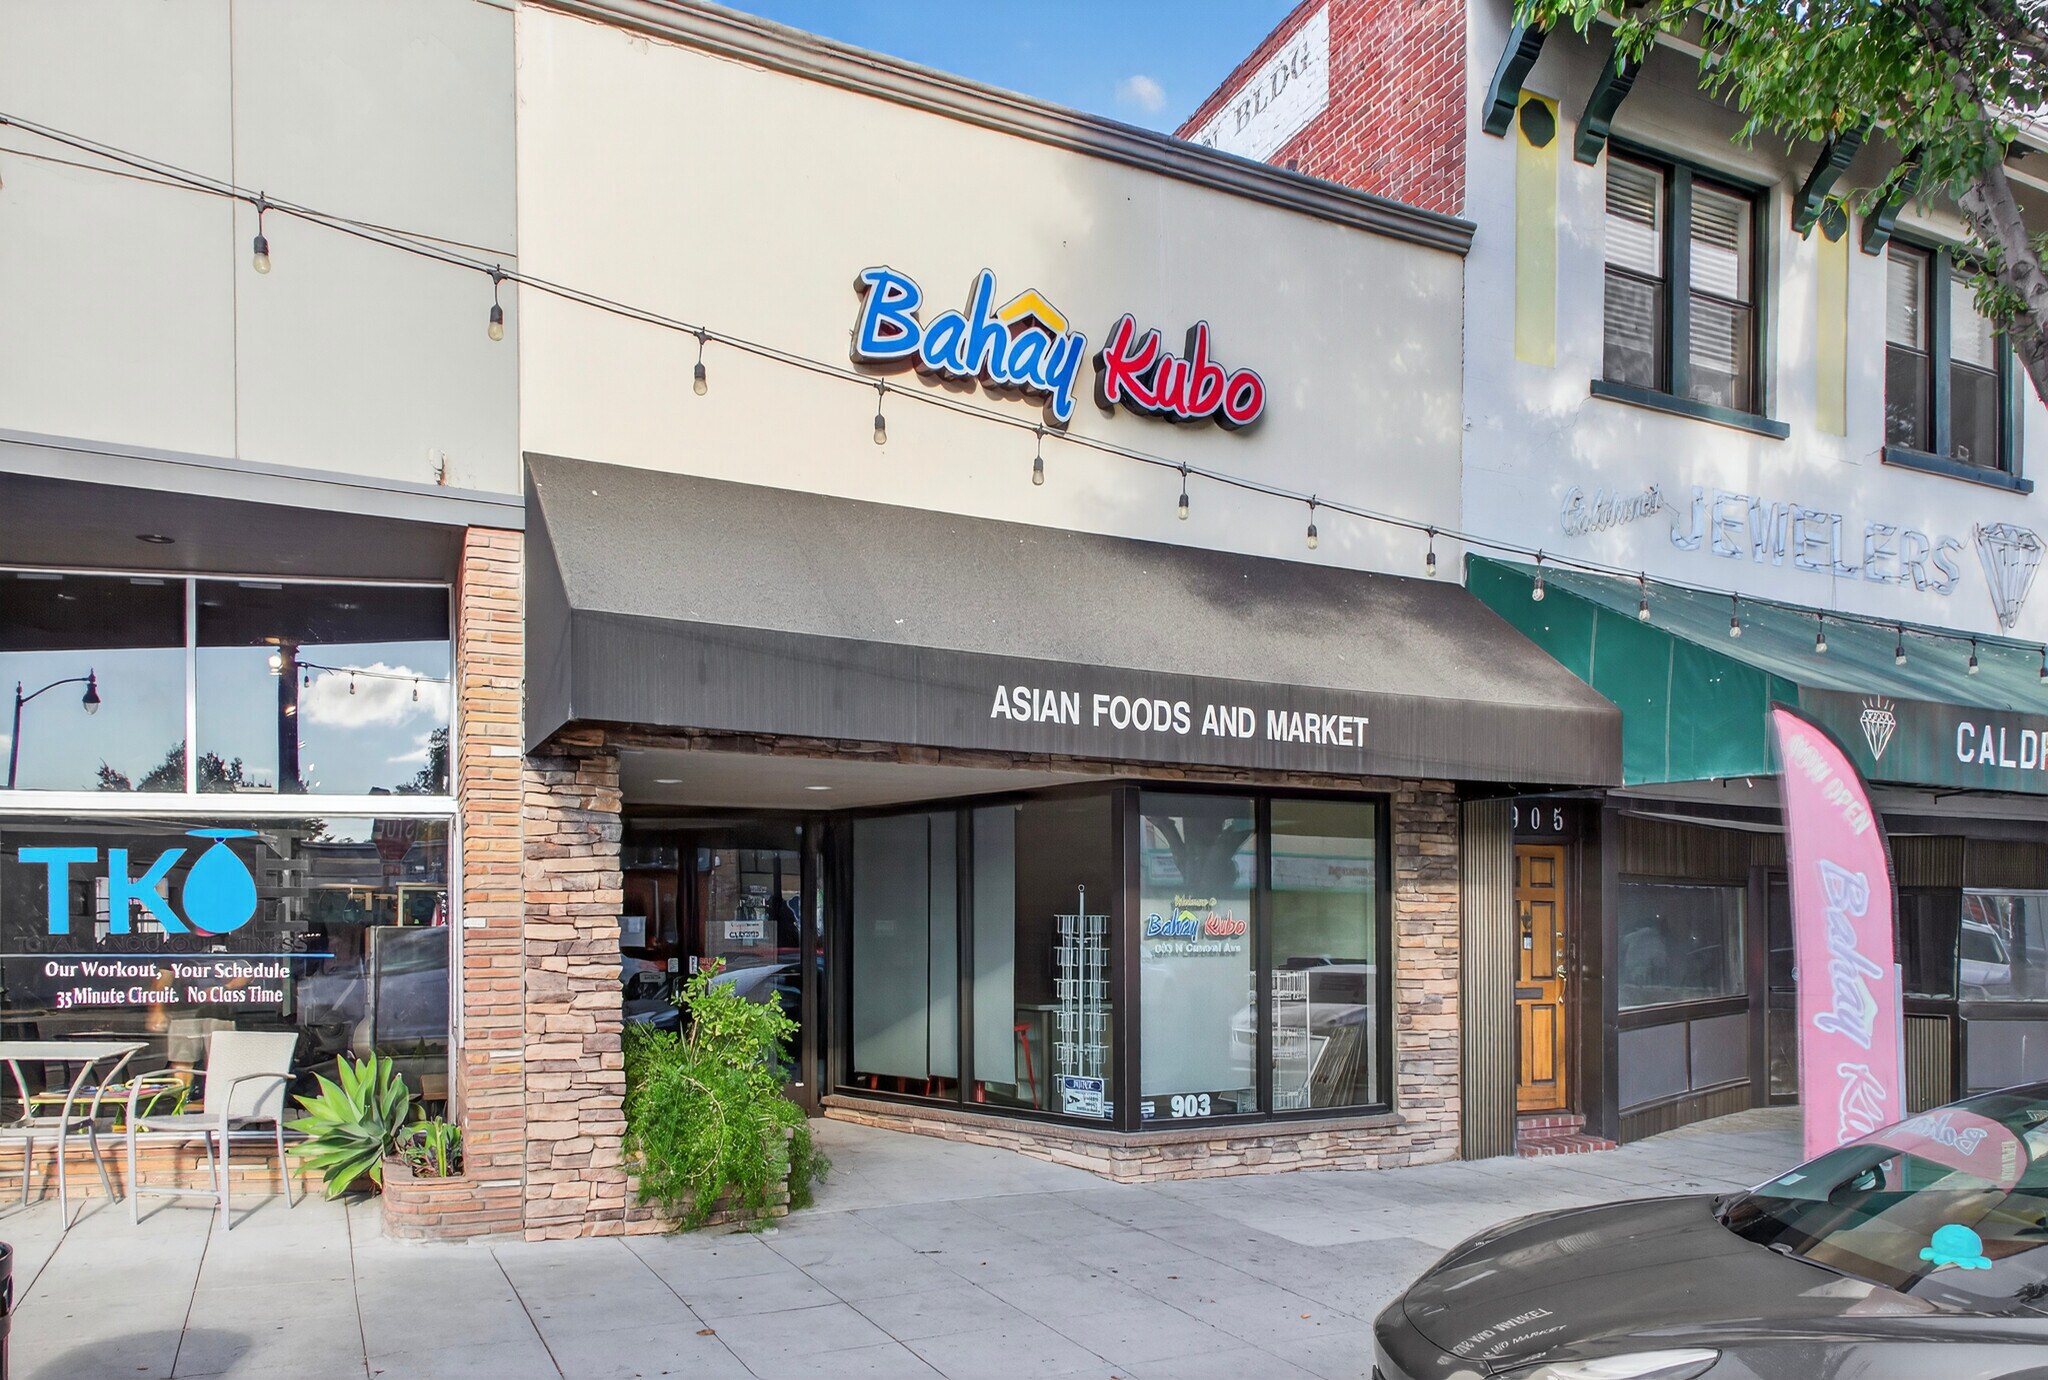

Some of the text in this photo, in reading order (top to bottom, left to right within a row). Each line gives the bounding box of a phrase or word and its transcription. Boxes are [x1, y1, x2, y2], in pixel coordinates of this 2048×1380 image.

[854, 265, 1267, 429] Bahay Kubo
[1669, 487, 1964, 596] JEWELERS
[991, 685, 1369, 748] ASIAN FOODS AND MARKET
[1823, 777, 1872, 836] OPEN
[18, 828, 258, 935] TKO
[1204, 908, 1247, 936] Kubo
[45, 961, 291, 980] Our Workout, Your Schedule
[73, 987, 126, 1004] Minute
[128, 986, 180, 1004] Circuit.
[188, 986, 207, 1004] No
[210, 986, 246, 1003] Class
[248, 986, 284, 1003] Time
[1812, 858, 1887, 1144] Bahay Ku
[1170, 1093, 1212, 1118] 903
